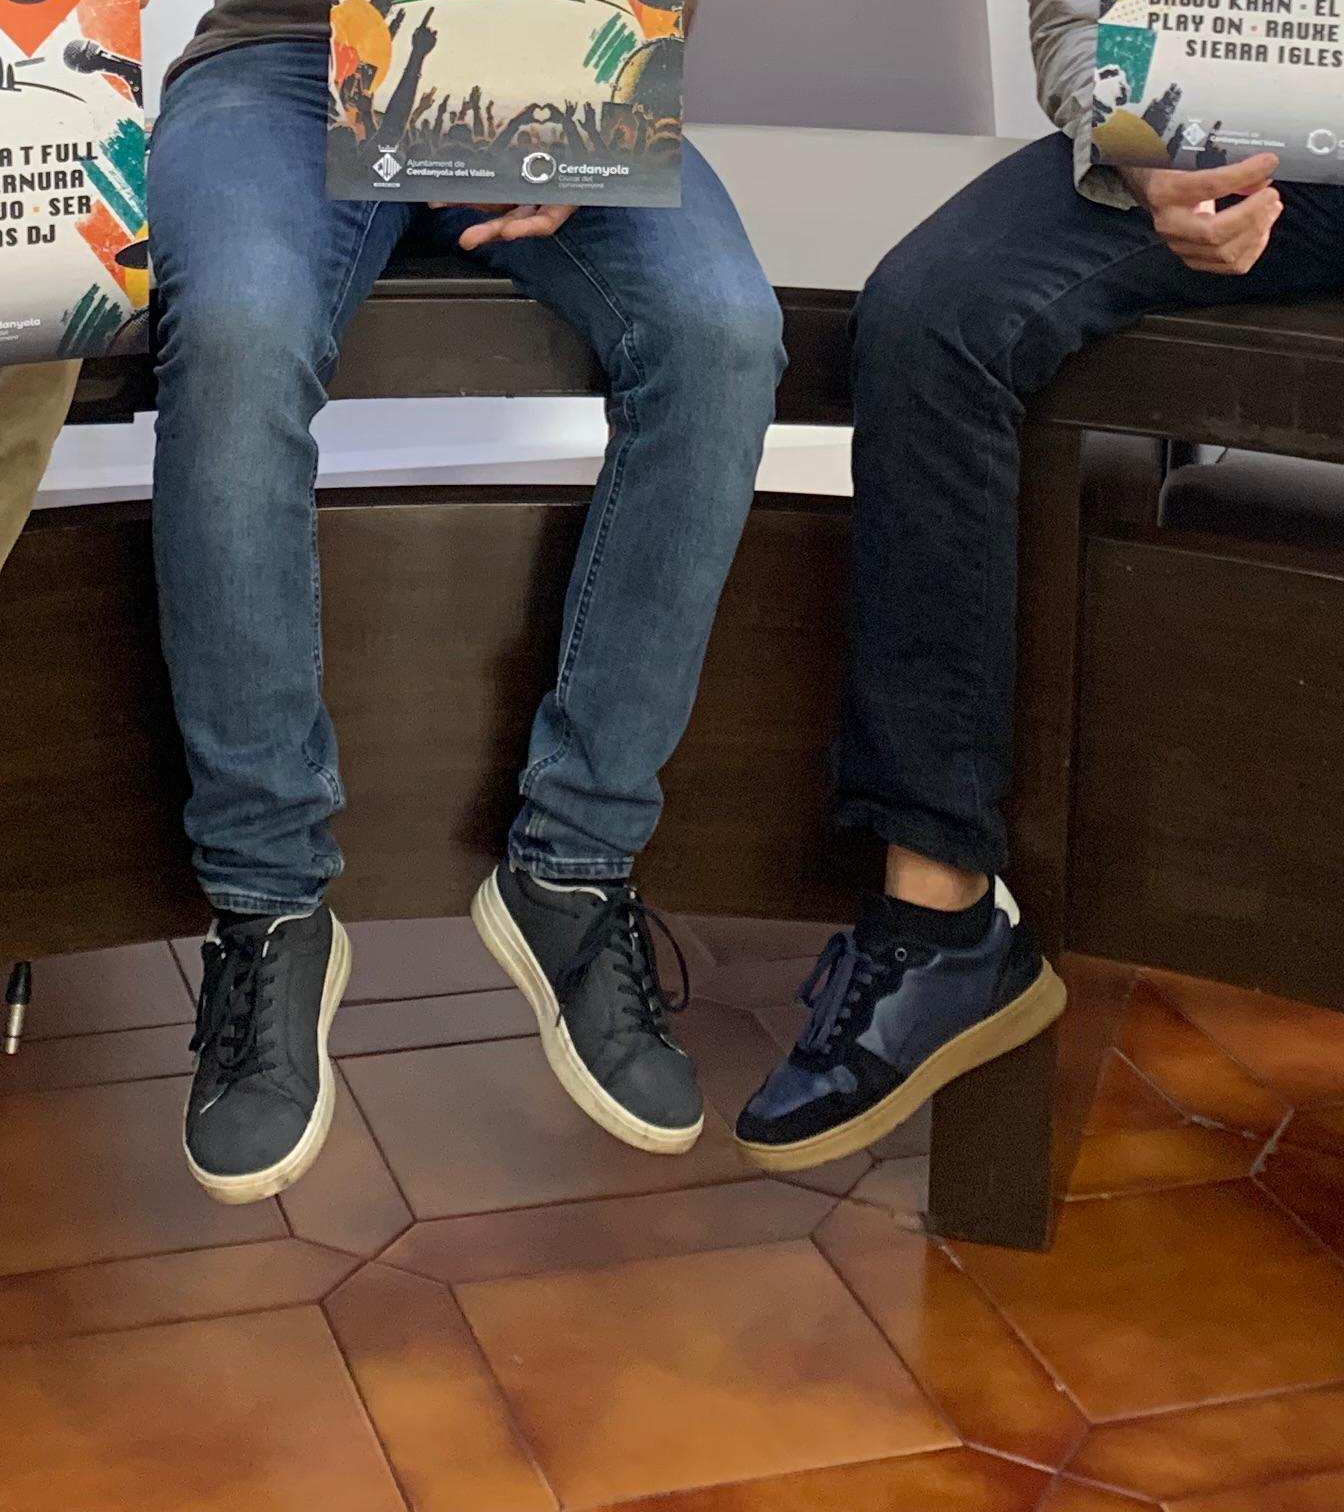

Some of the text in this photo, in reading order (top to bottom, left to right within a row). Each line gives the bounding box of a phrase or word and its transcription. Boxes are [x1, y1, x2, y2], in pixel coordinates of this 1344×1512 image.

[1148, 12, 1204, 32] PLAY
[1212, 16, 1243, 35] ON
[1266, 20, 1339, 42] RAUXE
[1185, 39, 1268, 62] SIERRA
[406, 168, 454, 178] Cerdanyola
[455, 168, 469, 176] del
[558, 164, 629, 176] Cerdanyola
[48, 195, 92, 216] SER
[27, 224, 56, 245] DJ
